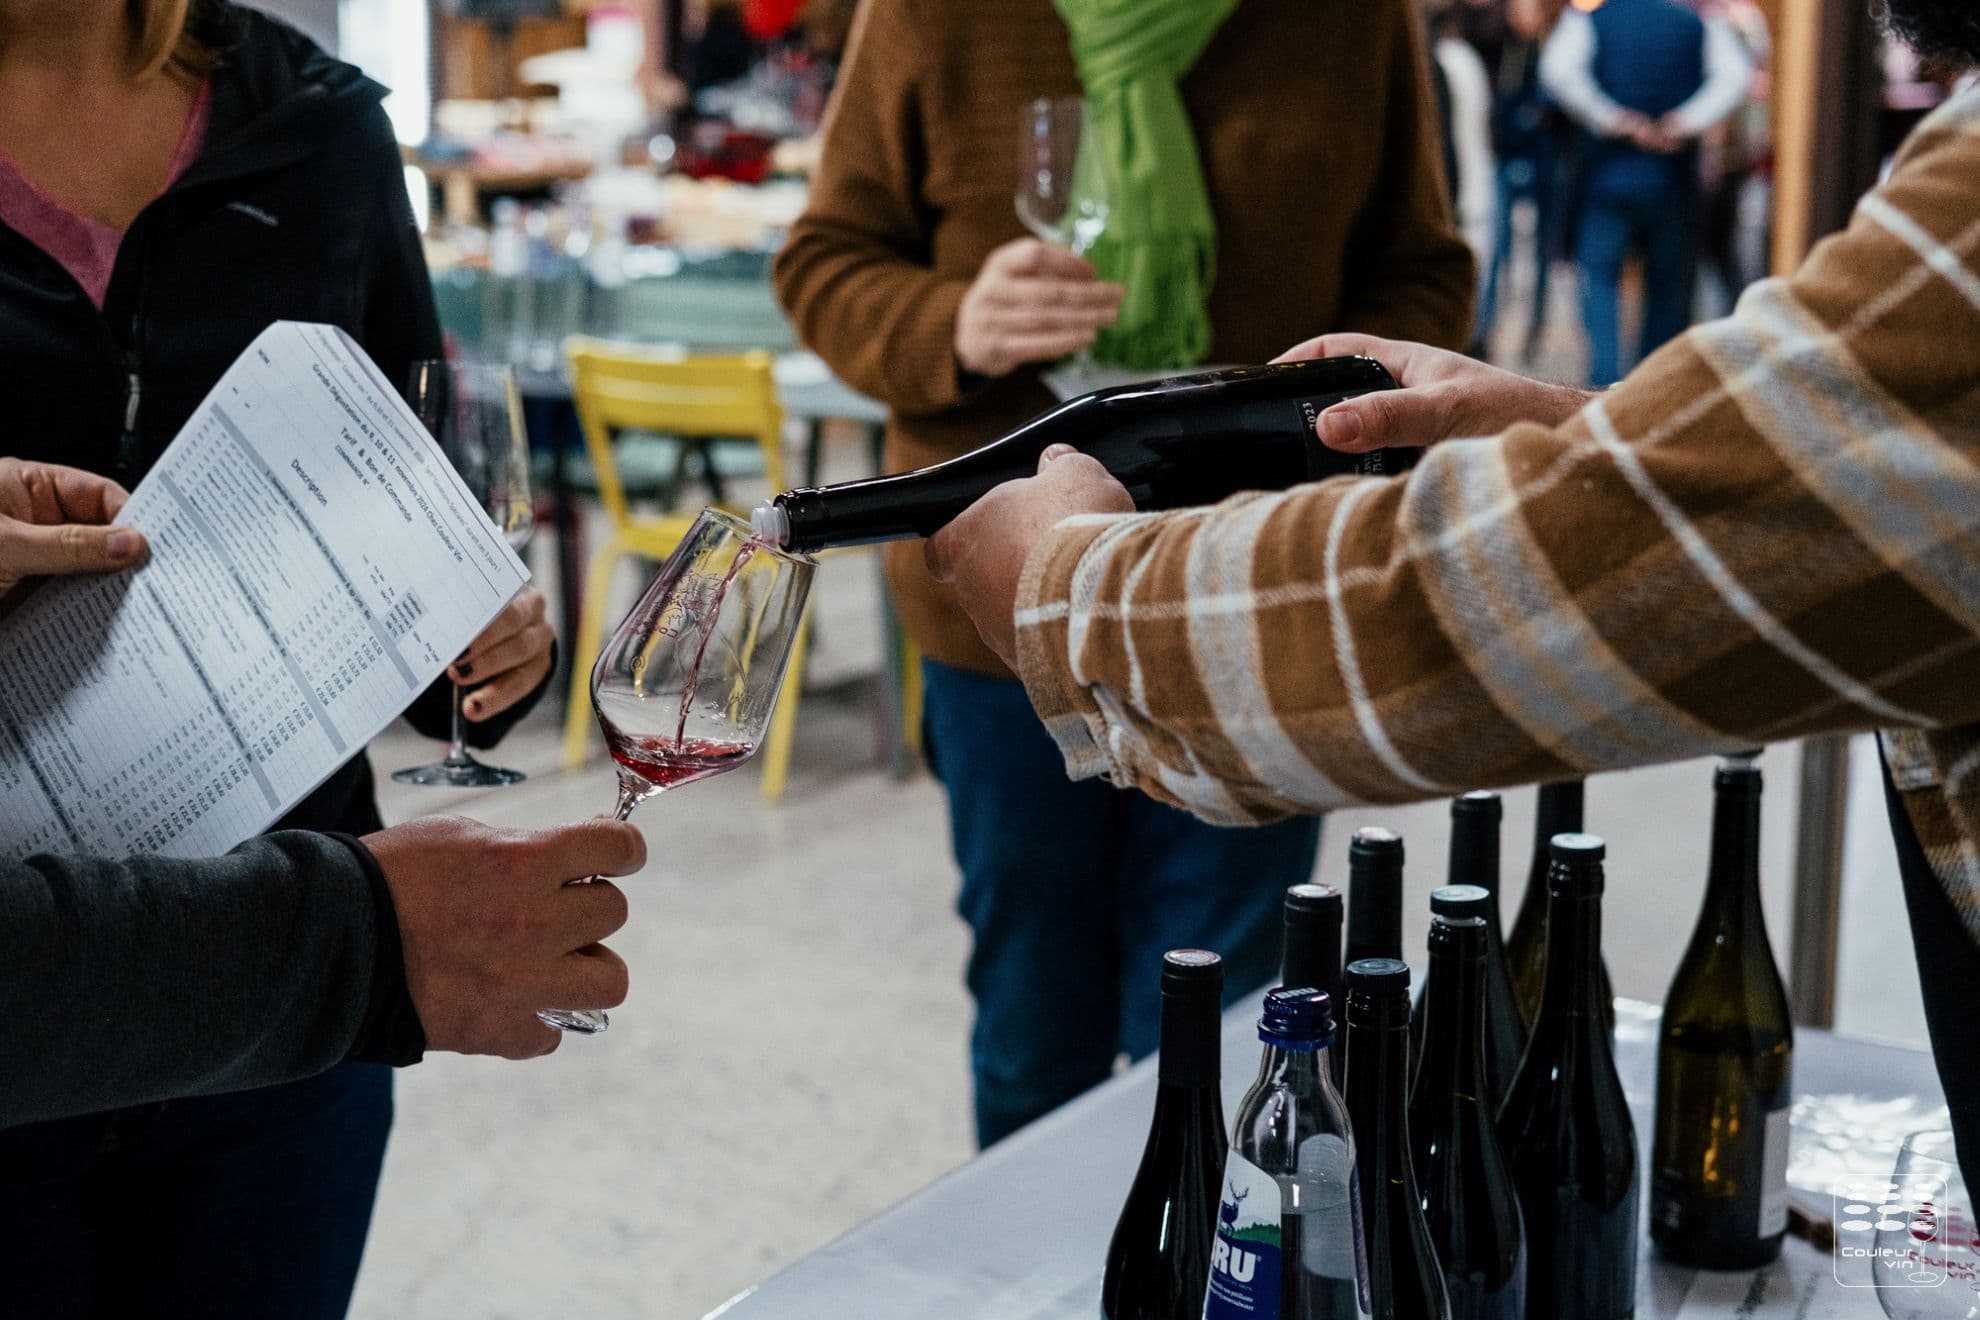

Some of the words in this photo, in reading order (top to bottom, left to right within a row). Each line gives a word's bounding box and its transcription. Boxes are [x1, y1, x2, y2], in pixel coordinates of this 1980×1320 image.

[312, 363, 331, 387] Grande
[360, 423, 370, 433] du
[374, 439, 383, 449] 10
[386, 454, 396, 464] 11
[394, 465, 419, 496] novembre
[339, 426, 357, 446] Tarif
[357, 448, 366, 457] &
[365, 457, 380, 474] Bon
[376, 472, 387, 484] de
[383, 482, 415, 522] Commande
[289, 458, 329, 507] Description
